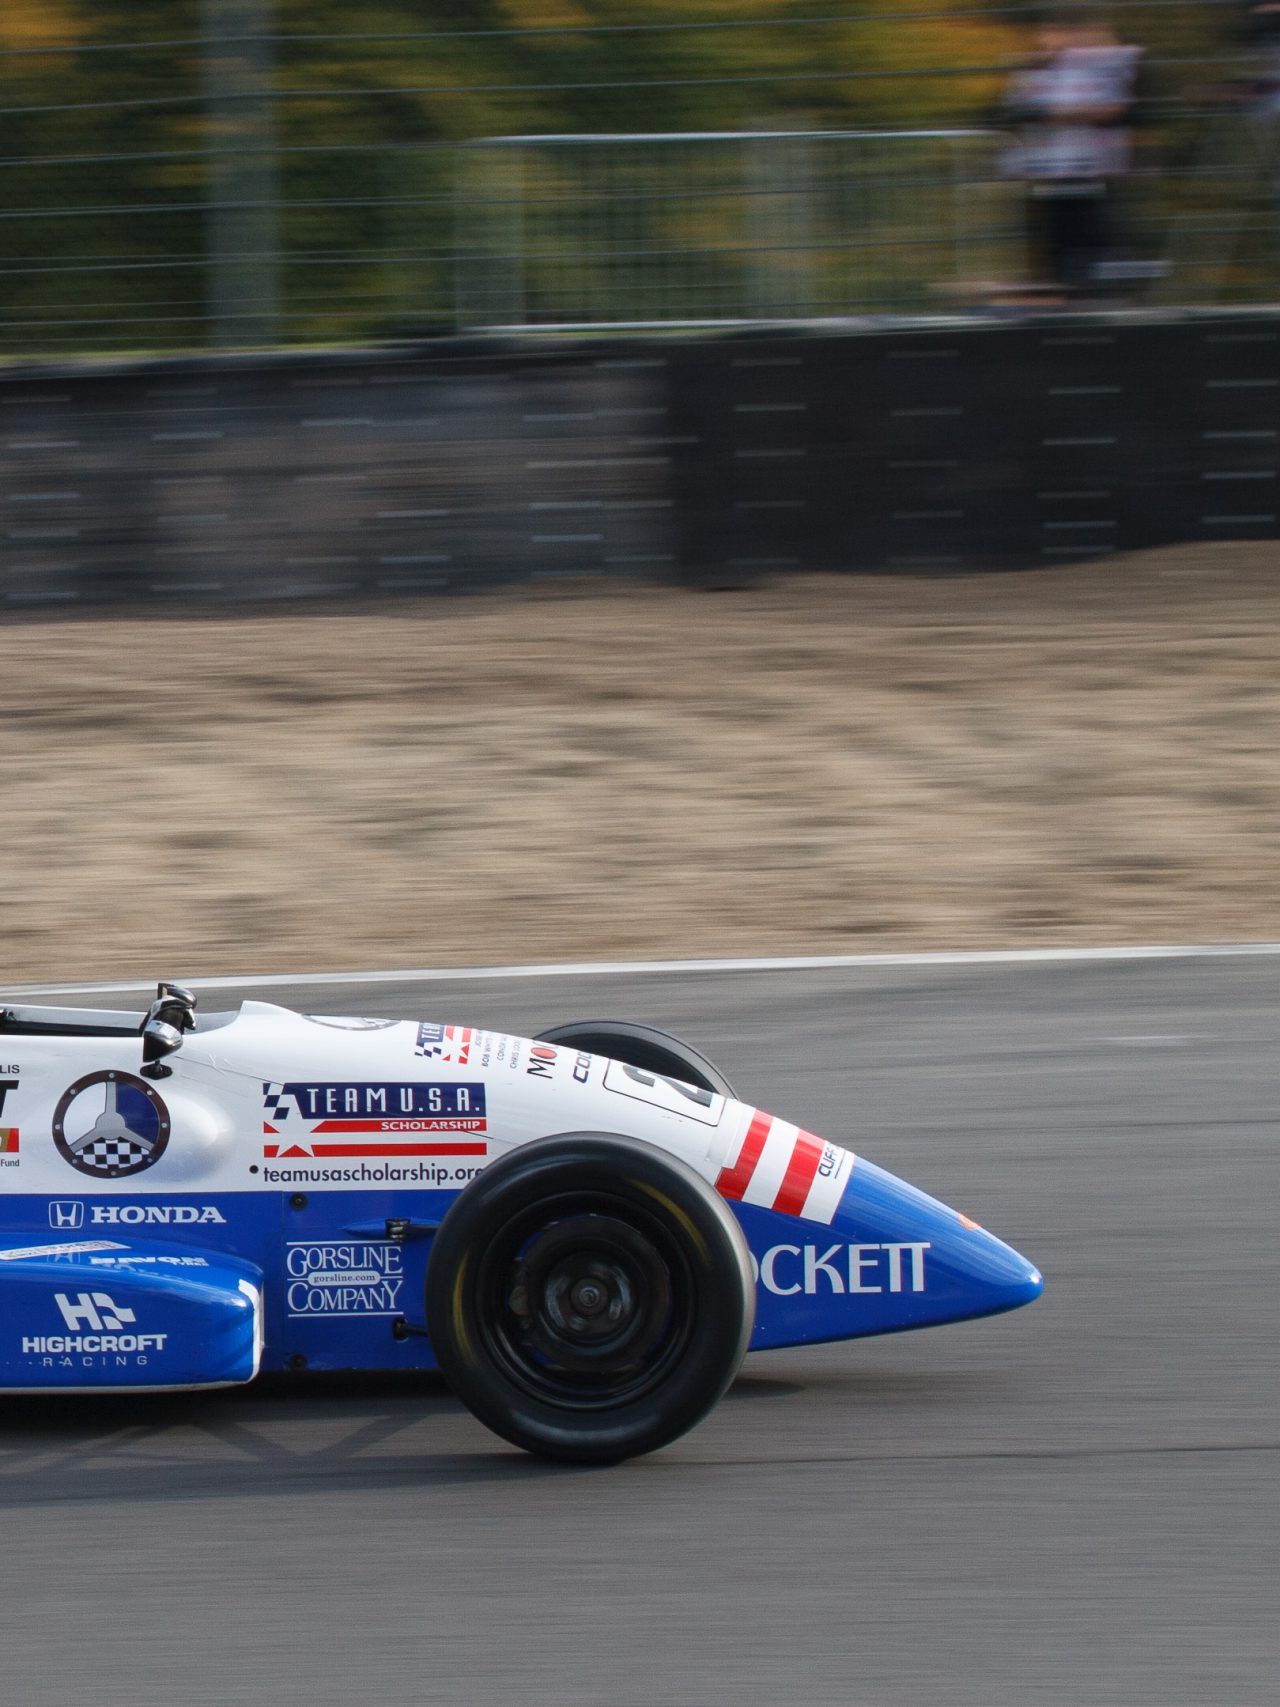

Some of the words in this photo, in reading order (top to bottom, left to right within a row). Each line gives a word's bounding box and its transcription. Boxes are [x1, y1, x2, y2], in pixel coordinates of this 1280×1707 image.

[307, 1088, 387, 1113] TEAM
[400, 1087, 481, 1112] U.S.A.
[380, 1120, 481, 1131] SCHOLARSHIP
[0, 1159, 20, 1169] Fund
[90, 1206, 227, 1224] HONDA
[286, 1246, 404, 1277] GORSLINE
[749, 1241, 931, 1295] CKETT
[313, 1273, 376, 1284] gorsline.com
[287, 1279, 404, 1312] COMPANY
[22, 1334, 168, 1353] HIGHCROFT
[42, 1356, 149, 1366] RACING
